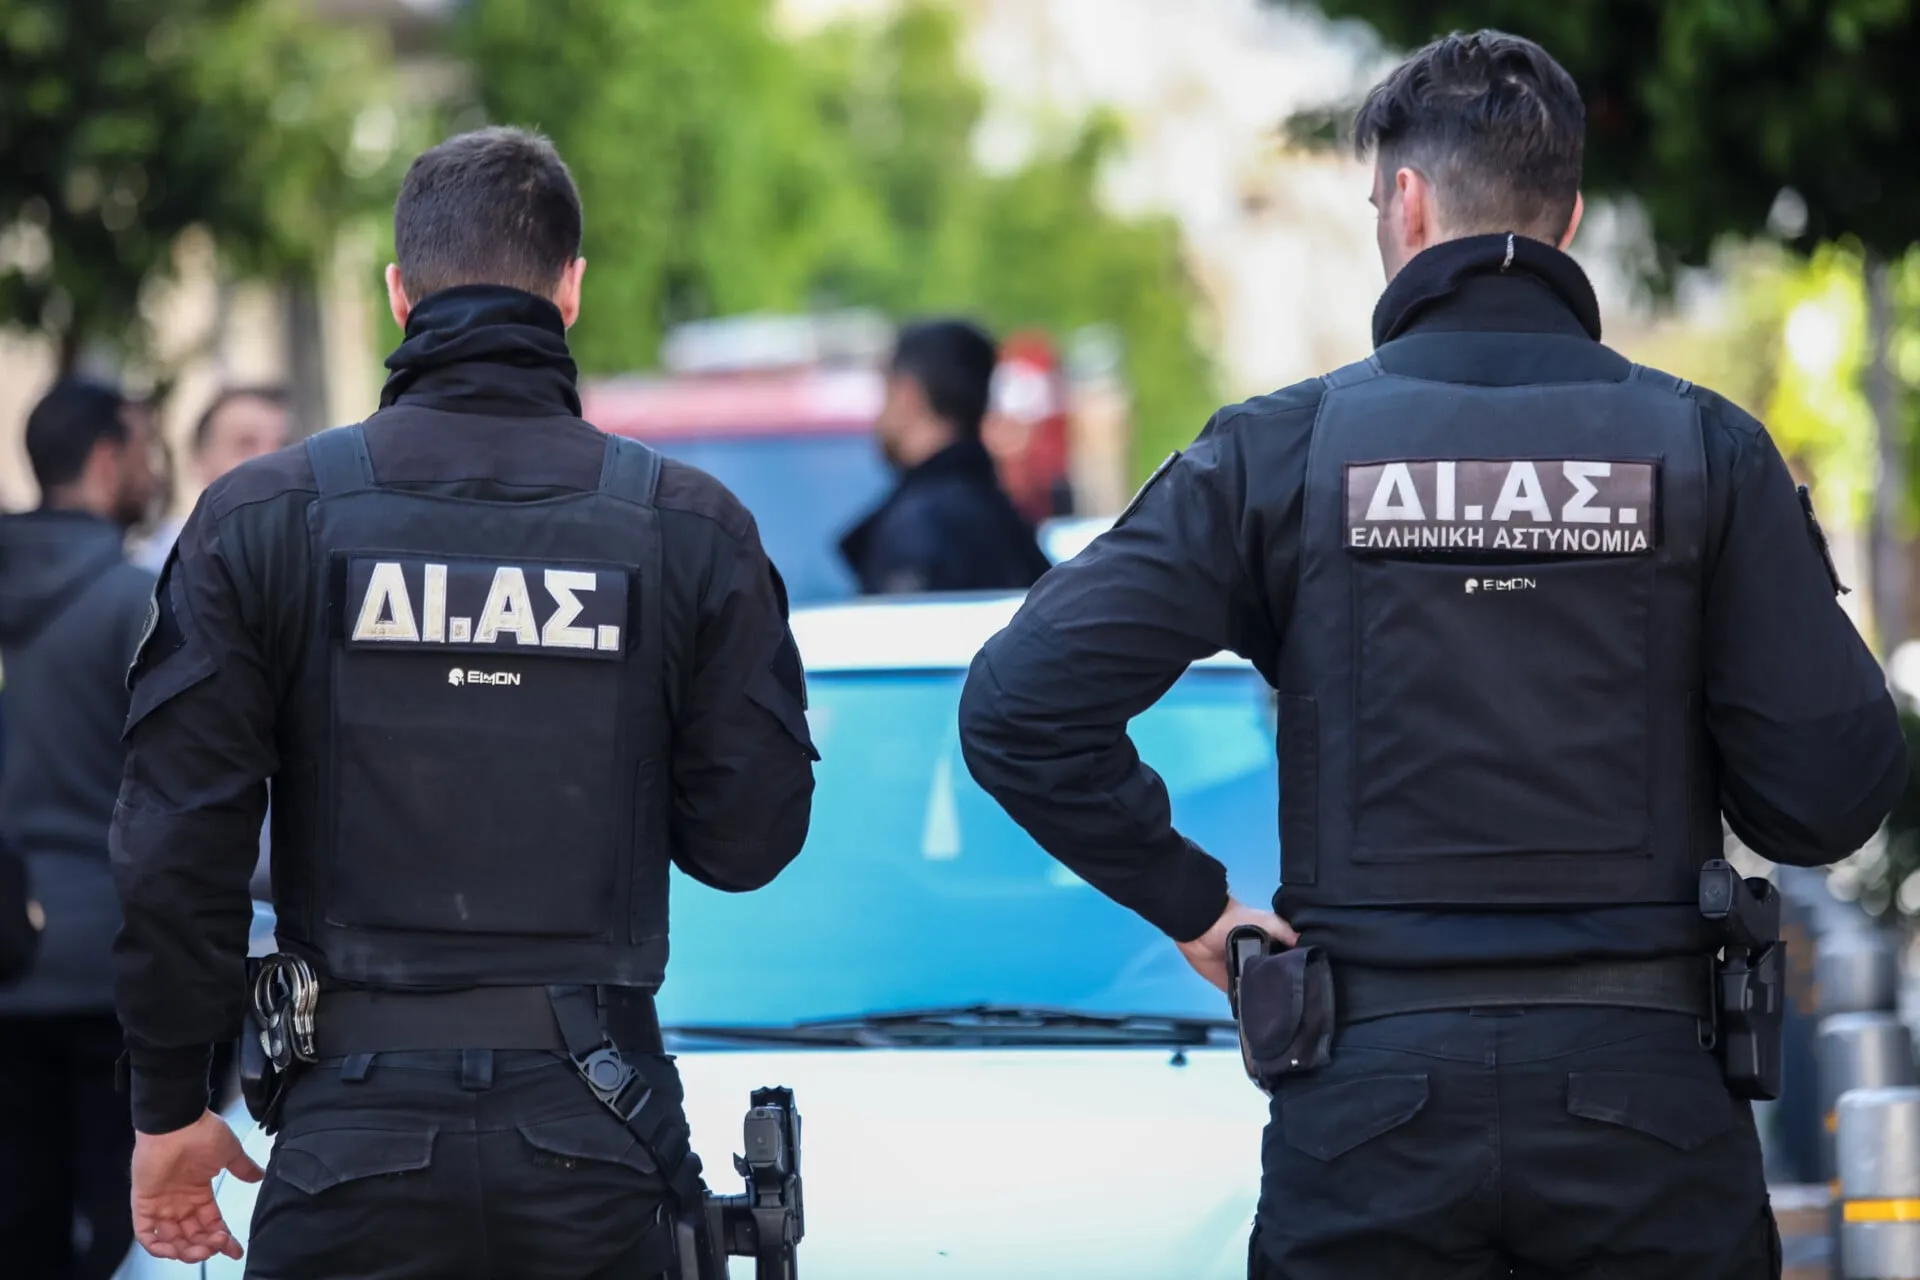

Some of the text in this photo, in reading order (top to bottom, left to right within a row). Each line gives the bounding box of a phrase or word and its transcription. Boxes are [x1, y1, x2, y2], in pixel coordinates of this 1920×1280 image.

[1365, 461, 1638, 524] ΔΙ.ΑΣ.
[1351, 527, 1648, 552] ΕΛΛΗΝΙΚΗ ΑΣΤΥΝΟΜΙΑ
[1483, 577, 1536, 591] ELMON
[352, 562, 621, 651] ΔΙ.ΑΣ.
[467, 670, 521, 686] ELMON
